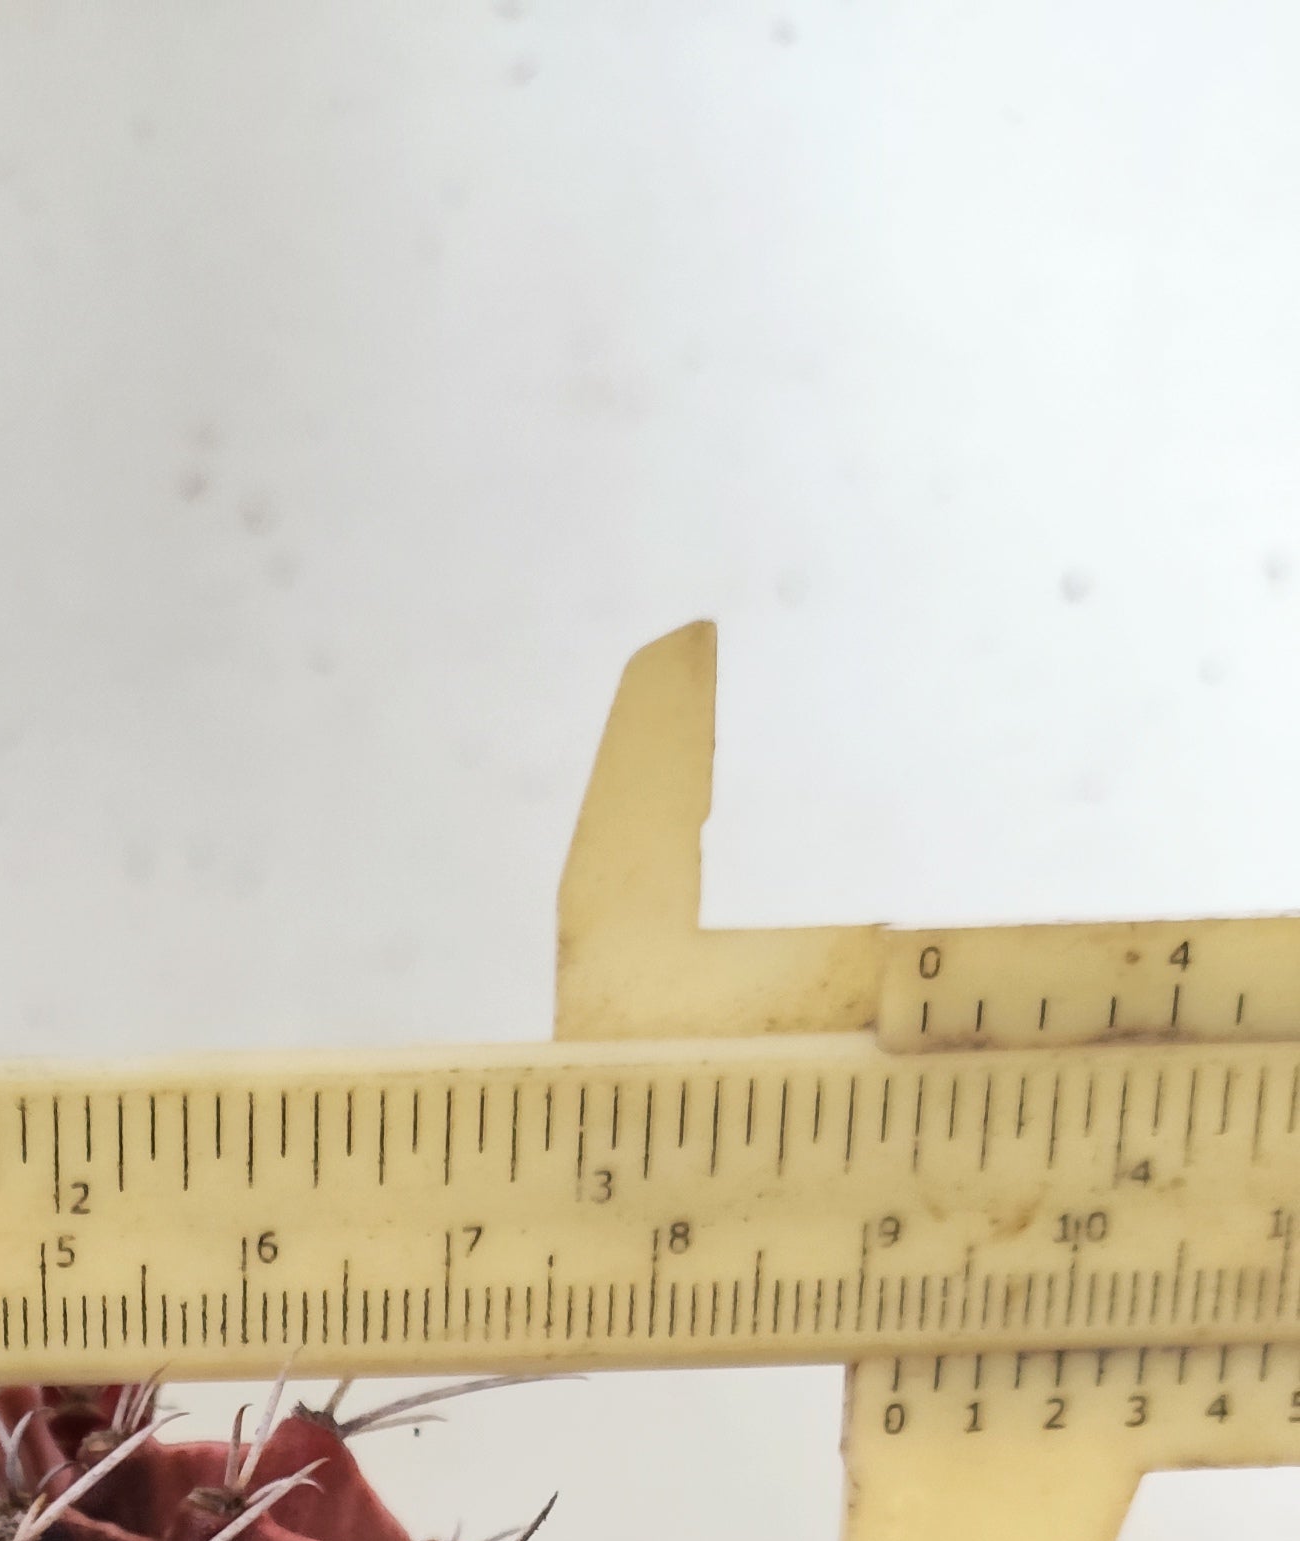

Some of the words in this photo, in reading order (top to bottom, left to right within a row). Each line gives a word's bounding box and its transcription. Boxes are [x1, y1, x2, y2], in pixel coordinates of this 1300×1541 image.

[918, 945, 942, 980] 0
[1169, 940, 1191, 972] 4
[70, 1182, 91, 1215] 2
[594, 1170, 614, 1204] 3
[1129, 1159, 1153, 1186] 4
[56, 1235, 75, 1268] 5
[257, 1231, 278, 1264] 6
[461, 1225, 483, 1258] 7
[668, 1222, 691, 1254] 8
[877, 1215, 901, 1248] 9
[1052, 1210, 1109, 1244] 10
[883, 1403, 905, 1435] 0
[963, 1401, 984, 1433] 1
[1042, 1397, 1066, 1430] 2
[1124, 1394, 1148, 1428] 3
[1204, 1392, 1230, 1423] 4
